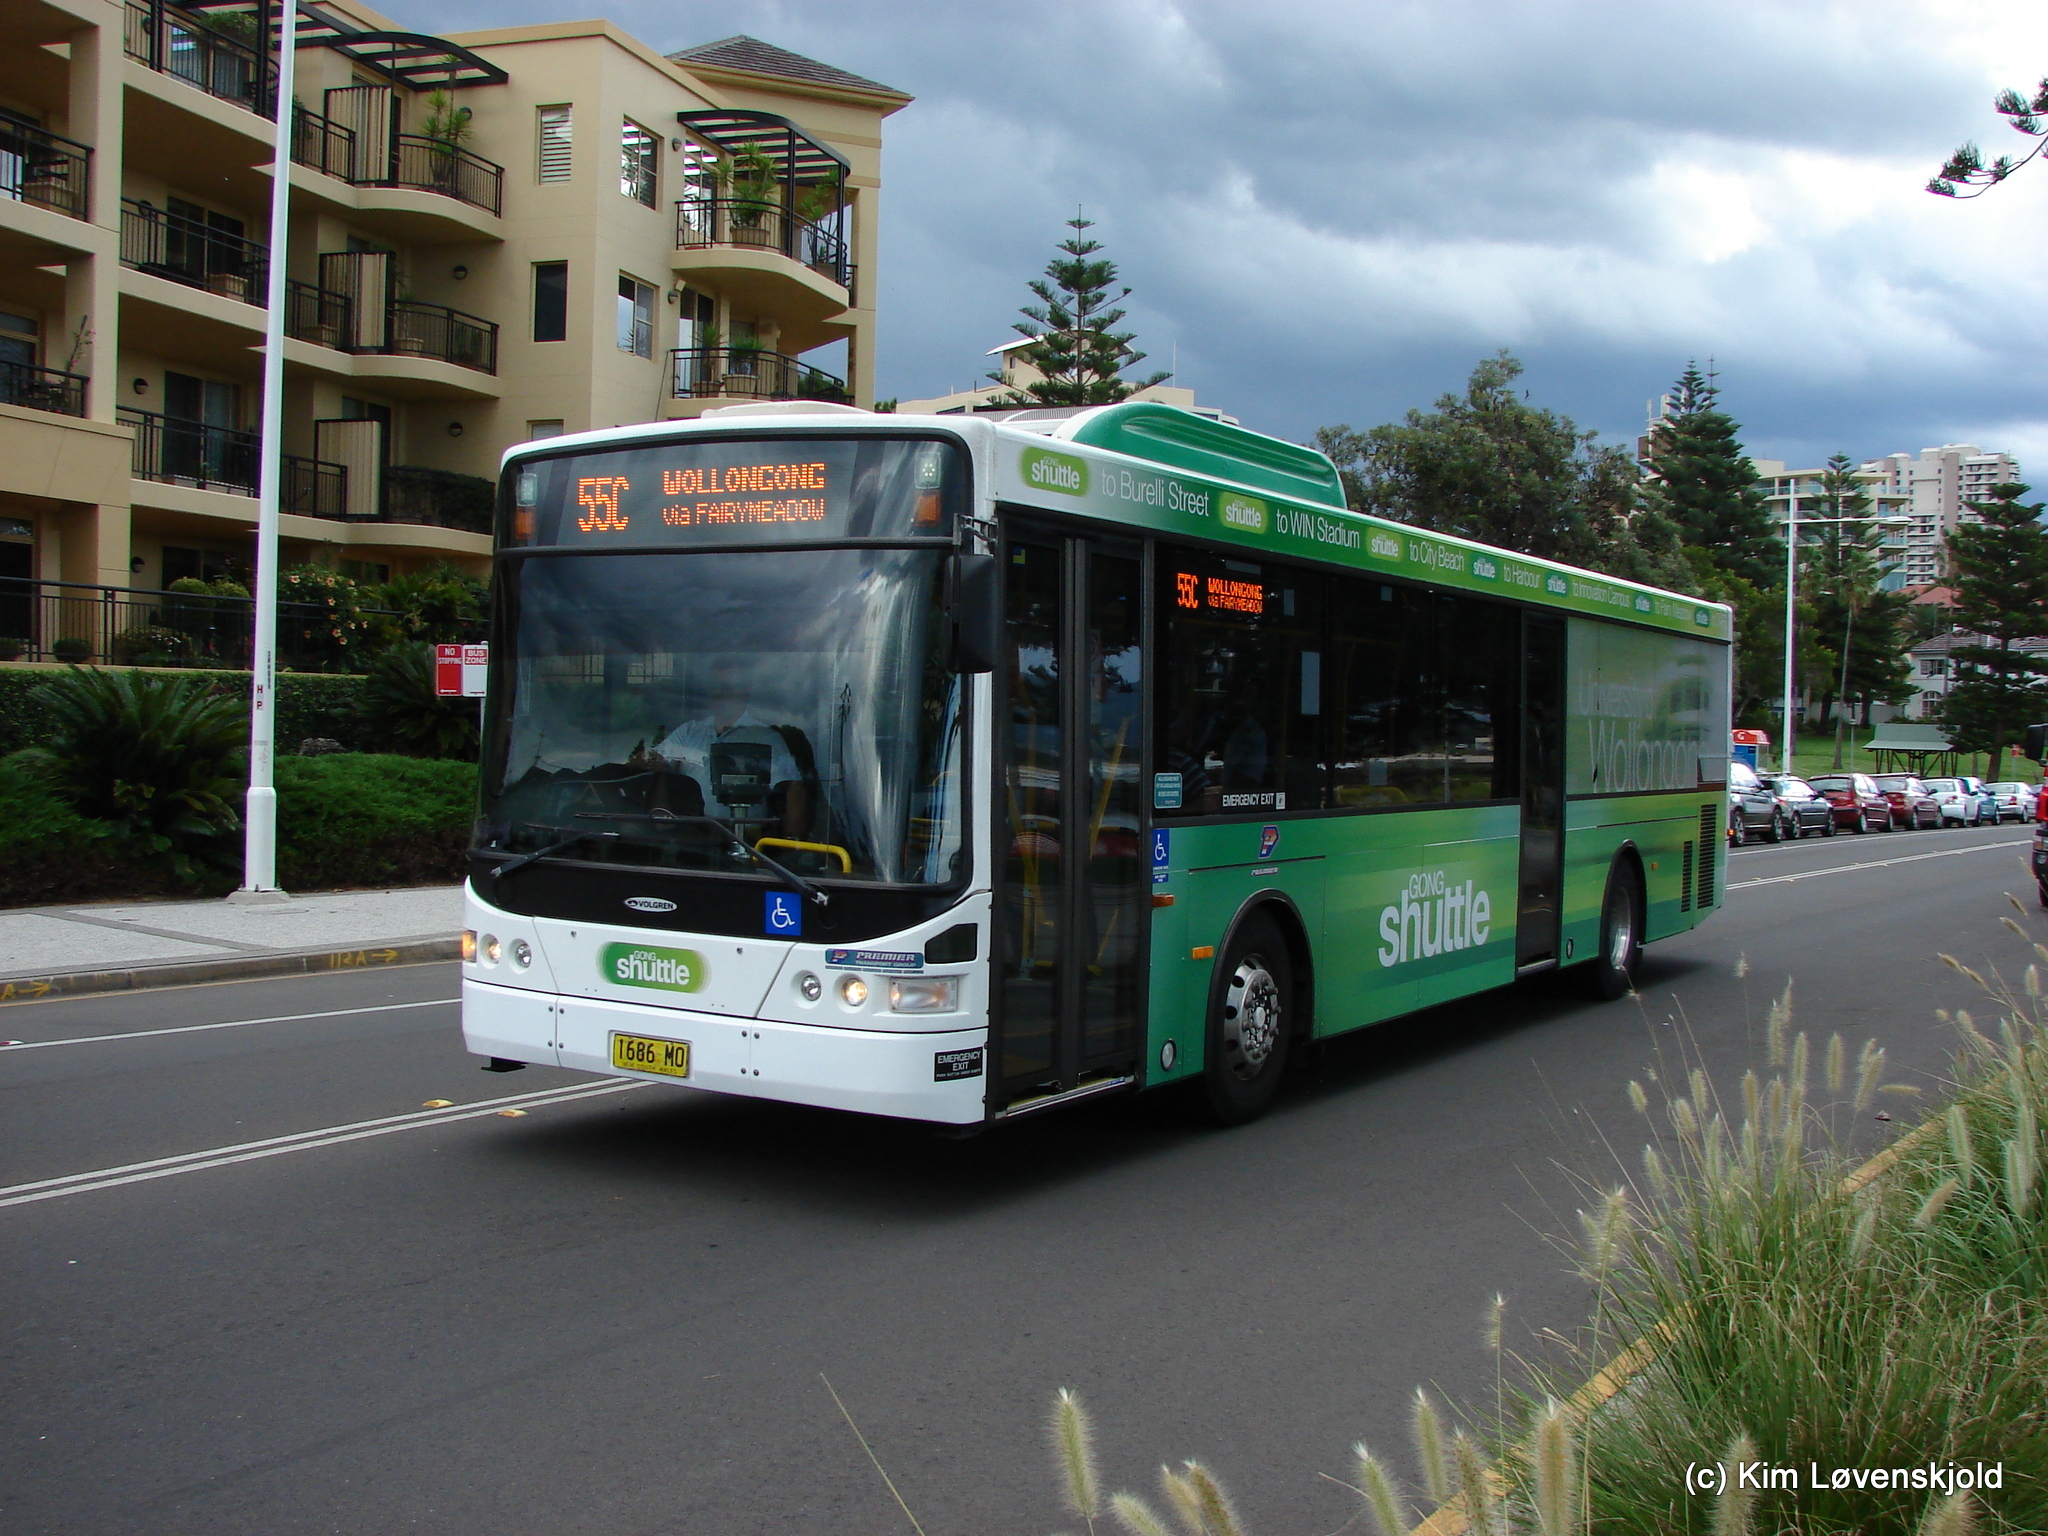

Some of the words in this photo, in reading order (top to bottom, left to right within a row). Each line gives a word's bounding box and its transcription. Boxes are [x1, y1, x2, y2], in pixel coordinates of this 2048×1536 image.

[663, 463, 826, 496] WOLLONGONG
[1031, 460, 1080, 490] shuttle
[577, 476, 630, 532] 55C
[1101, 469, 1116, 497] to
[1120, 471, 1164, 507] Burelli
[1168, 481, 1209, 517] Street
[662, 503, 691, 526] via
[1225, 504, 1261, 528] shuttle
[1276, 509, 1288, 534] to
[1289, 510, 1314, 539] WIN
[1317, 517, 1360, 549] Stadium
[1371, 536, 1398, 557] shuttle
[1409, 541, 1418, 561] to
[1420, 541, 1437, 570] City
[1439, 545, 1464, 571] Beach
[1473, 558, 1495, 579] shuttle
[1503, 563, 1511, 581] to
[1512, 564, 1540, 588] Harbour
[1178, 573, 1198, 608] 55C
[1223, 794, 1260, 807] EMERGENCY
[1261, 793, 1275, 805] EXIT
[1409, 871, 1444, 899] GONG
[639, 901, 673, 909] VOLGREN
[1378, 880, 1490, 968] shuttle
[634, 951, 656, 961] GONG
[856, 952, 915, 961] PREMIER
[617, 955, 690, 986] shuttle
[620, 1039, 655, 1063] 1686
[938, 1051, 981, 1063] EMERGENCY
[953, 1061, 969, 1071] EXIT
